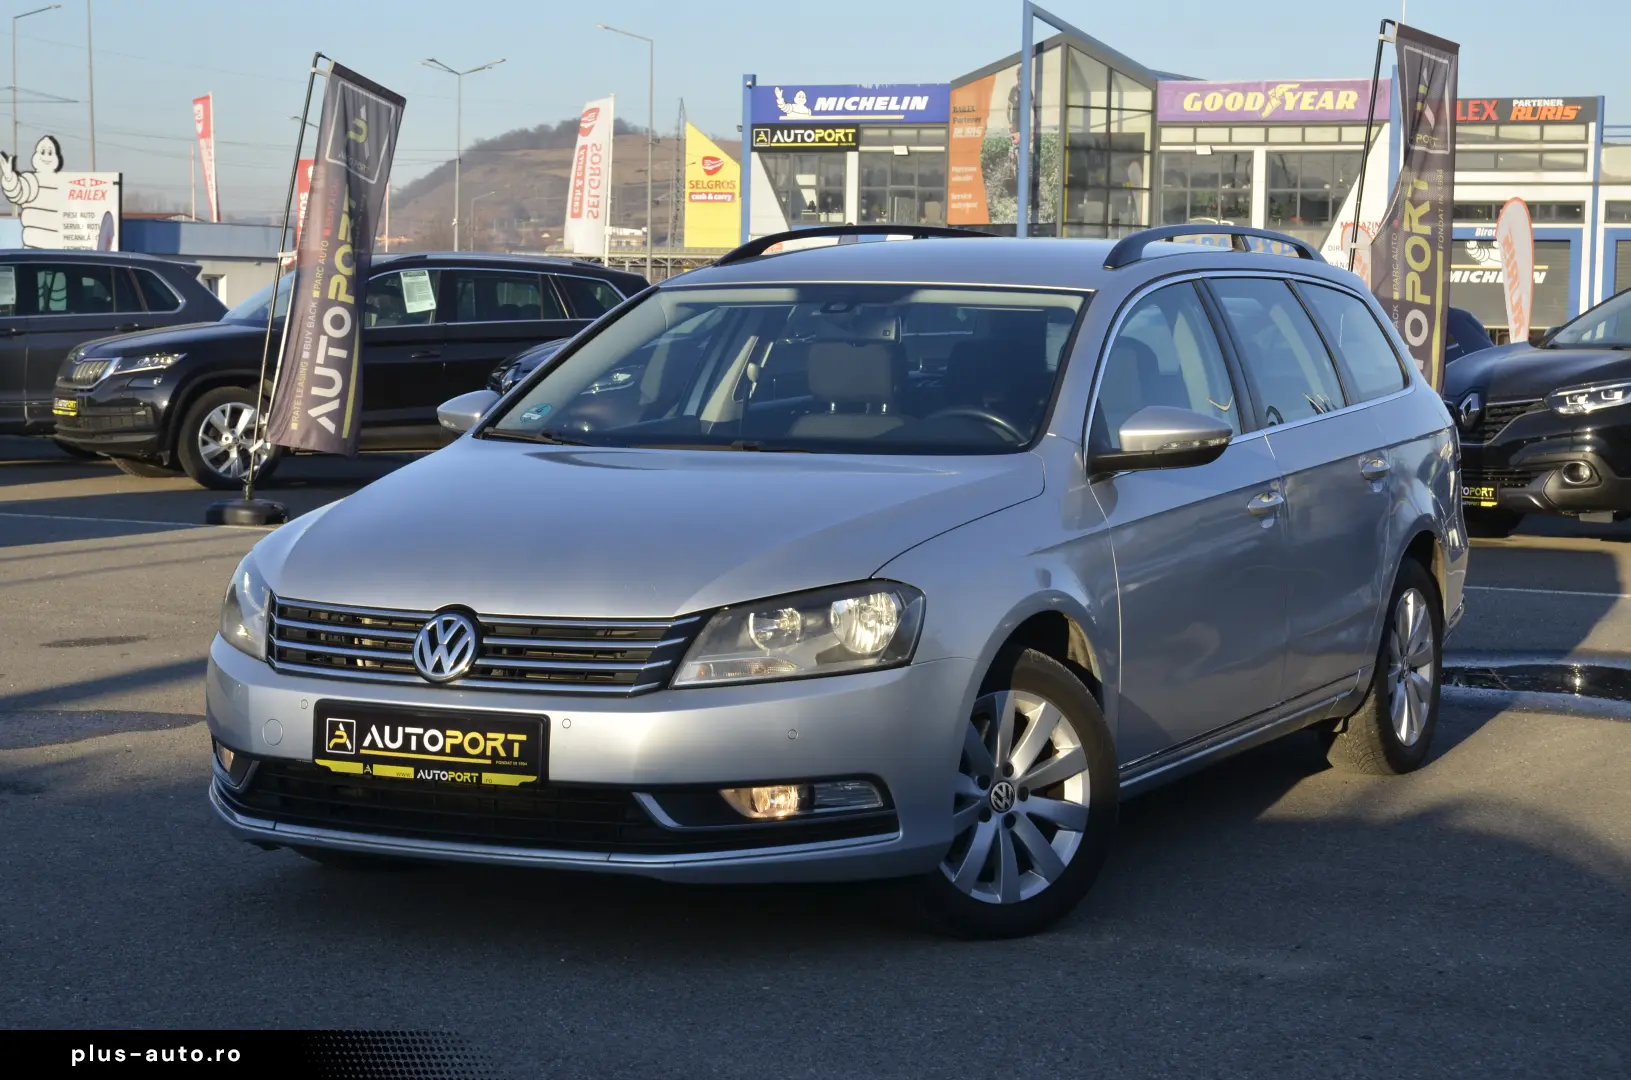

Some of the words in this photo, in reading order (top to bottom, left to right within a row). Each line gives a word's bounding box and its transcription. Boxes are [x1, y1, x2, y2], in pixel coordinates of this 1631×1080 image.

[814, 96, 928, 111] MICHELIN
[1512, 98, 1564, 107] PARTENER
[772, 129, 856, 142] AUTOPORT
[68, 189, 108, 201] RAILEX
[689, 180, 736, 190] SELGROS
[714, 193, 732, 202] carry
[318, 240, 329, 264] AUTO
[1391, 233, 1399, 259] AUTO
[313, 267, 325, 289] PARC
[1392, 263, 1400, 292] PARC
[306, 301, 318, 328] BACK
[303, 332, 313, 350] BUY
[295, 361, 308, 398] LEASING
[292, 400, 302, 422] RATE
[362, 724, 527, 758] AUTOPORT
[416, 769, 479, 783] AUTOPORT
